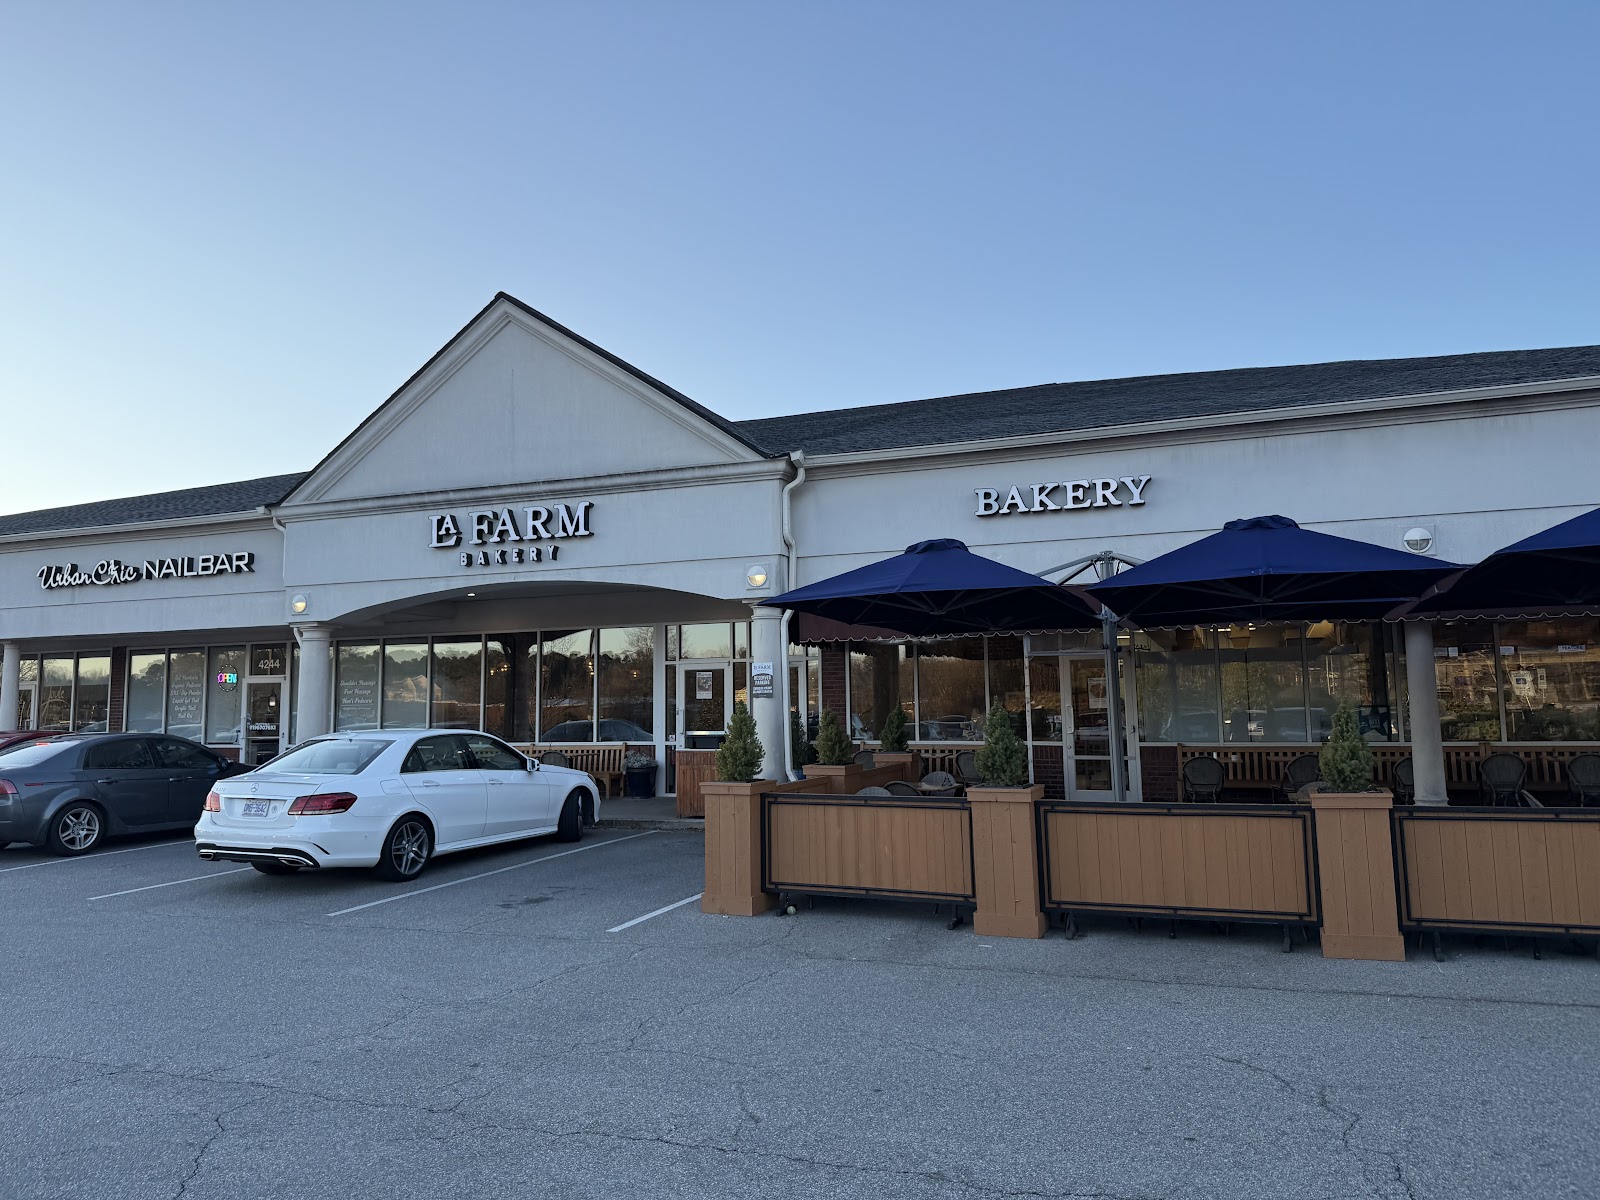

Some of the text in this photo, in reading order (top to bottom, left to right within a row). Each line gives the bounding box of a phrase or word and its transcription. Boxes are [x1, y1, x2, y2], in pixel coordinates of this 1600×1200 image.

[974, 474, 1152, 517] BAKERY
[468, 501, 591, 545] FARM
[460, 545, 559, 567] BAKERY
[36, 562, 92, 589] Urban
[91, 559, 138, 585] Chic
[258, 659, 280, 669] 4244
[217, 672, 238, 684] OPEN
